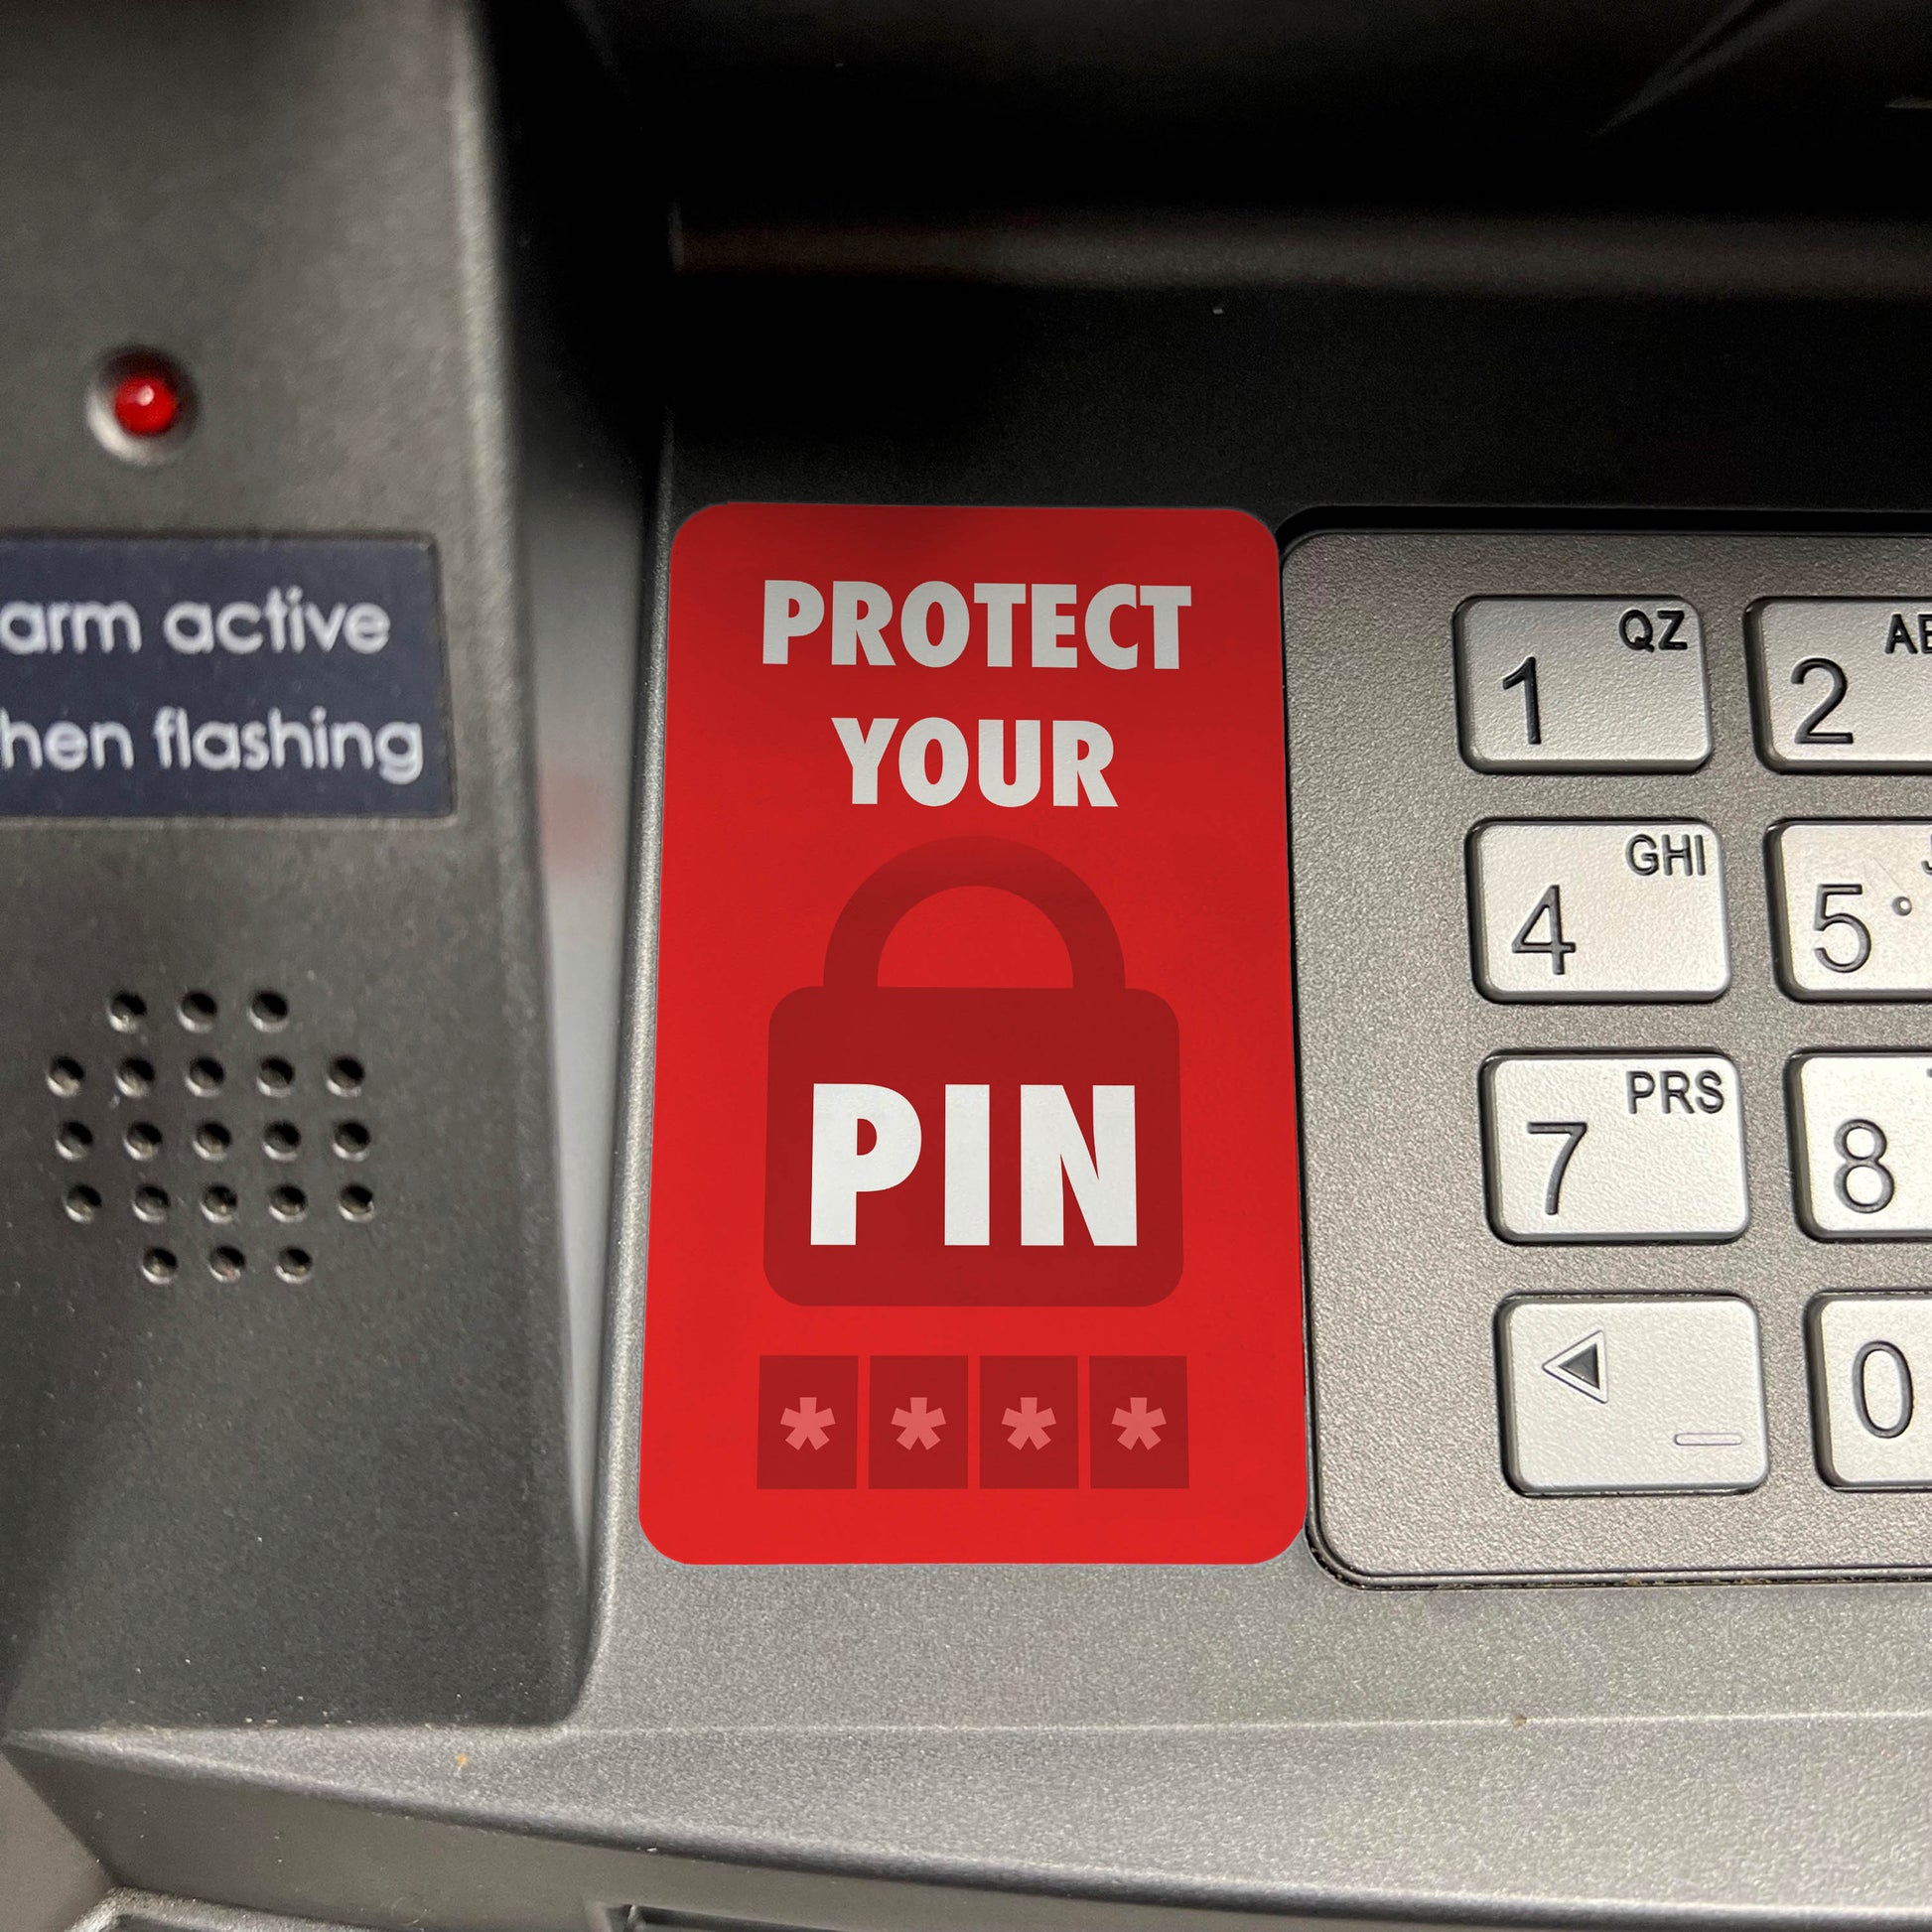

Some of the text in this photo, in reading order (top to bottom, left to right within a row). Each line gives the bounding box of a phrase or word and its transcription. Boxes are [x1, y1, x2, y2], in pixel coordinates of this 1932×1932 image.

[163, 586, 391, 655] active
[762, 579, 1192, 671] PROTECT
[1618, 609, 1688, 652] QZ
[154, 705, 423, 785] flashing
[1502, 656, 1542, 745] 1
[1790, 657, 1854, 745] 2
[830, 716, 1119, 808] YOUR
[1625, 834, 1707, 878] GHI
[1510, 884, 1577, 976] 4
[1813, 884, 1871, 974] 5
[1625, 1069, 1725, 1114] PRS
[810, 1082, 1138, 1247] PIN
[1526, 1121, 1588, 1216] 7
[1833, 1118, 1895, 1214] 8
[1851, 1340, 1914, 1440] 0
